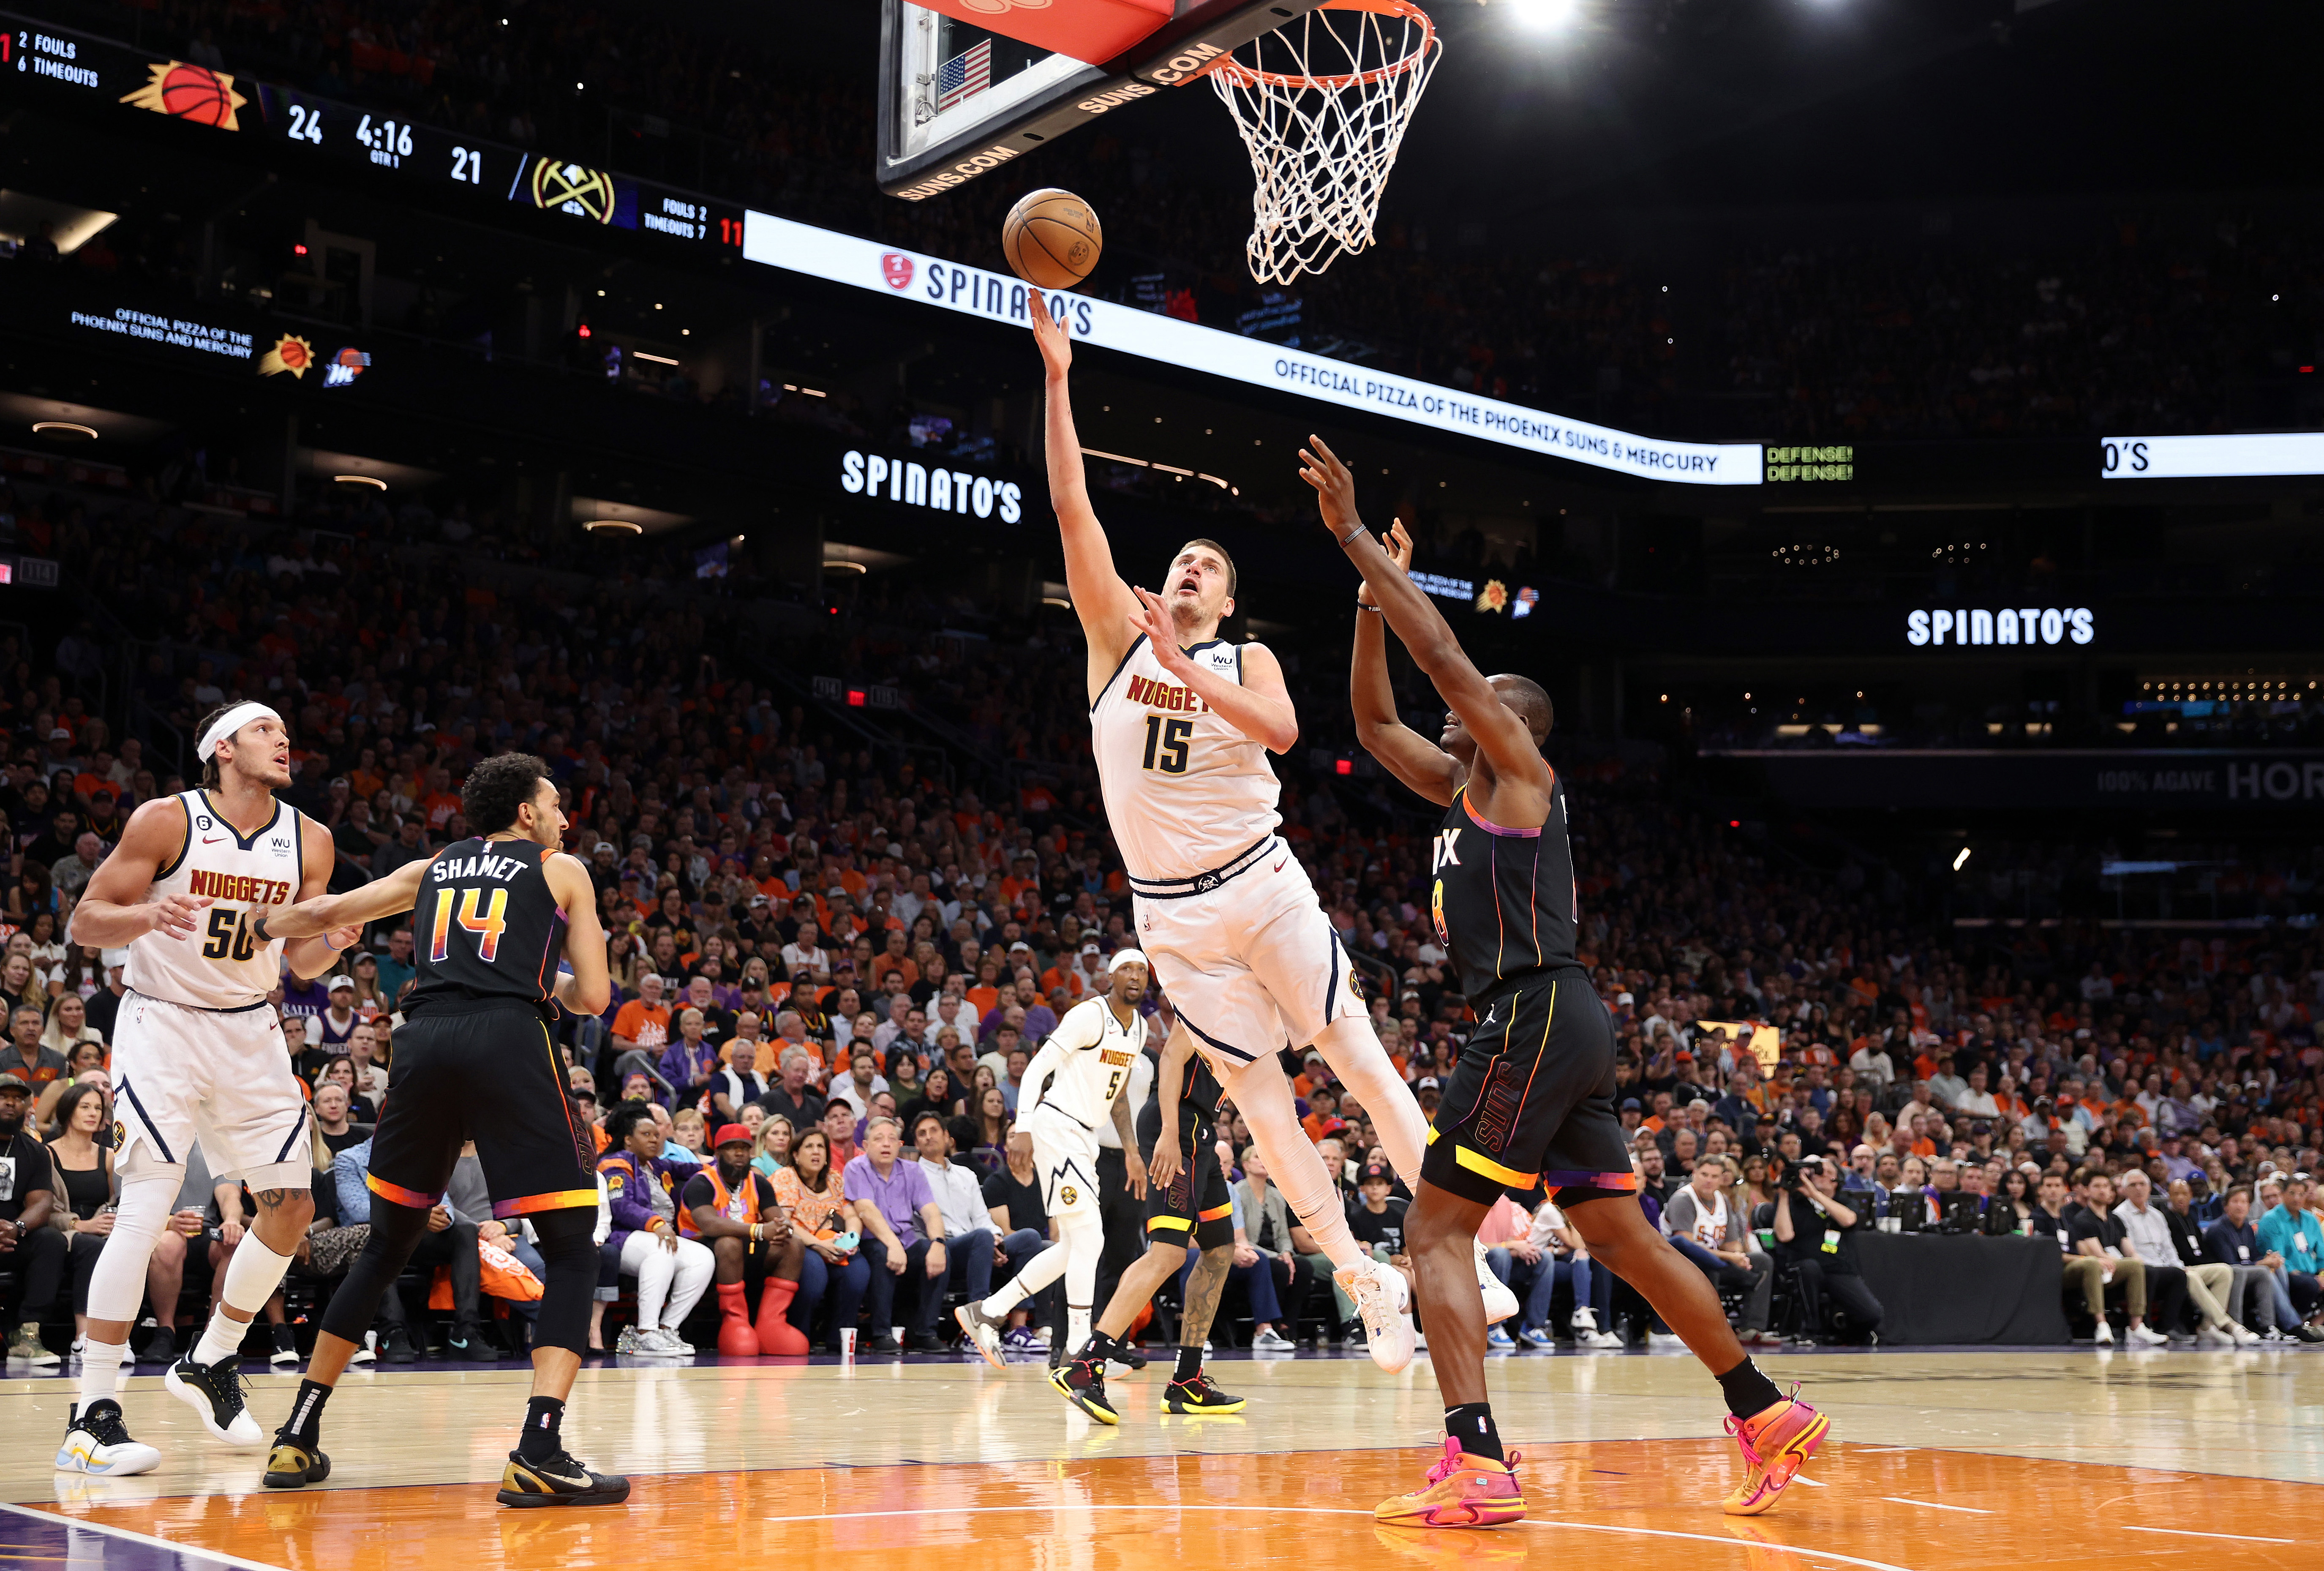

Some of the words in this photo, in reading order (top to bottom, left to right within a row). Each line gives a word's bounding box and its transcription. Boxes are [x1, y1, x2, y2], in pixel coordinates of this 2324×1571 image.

[19, 31, 27, 48] 2
[35, 33, 76, 59] FOULS
[18, 56, 26, 71] 6
[33, 56, 98, 87] TIMEOUTS
[1078, 43, 1225, 113] SUNS.COM
[288, 104, 322, 145] 24
[356, 115, 413, 156] 4:16
[370, 150, 391, 167] QTR
[393, 155, 399, 169] 1
[451, 146, 481, 184] 21
[897, 146, 1019, 201] SUNS.COM
[643, 213, 694, 239] TIMEOUTS
[698, 224, 706, 240] 7
[663, 198, 695, 219] FOULS
[699, 206, 707, 221] 2
[720, 218, 742, 247] 11
[927, 264, 1091, 335] SPINAO'S
[71, 311, 128, 334] PHOENIX
[129, 323, 164, 342] SUNS
[165, 332, 193, 347] AND
[194, 337, 253, 359] MERCURY
[115, 308, 171, 330] OFFICIAL
[173, 319, 209, 338] PIZZA
[210, 327, 227, 341] OF
[229, 330, 253, 347] THE
[1275, 359, 1361, 396] OFFICIAL
[1367, 382, 1418, 409] PIZZA
[1423, 396, 1444, 414] OF
[1449, 402, 1478, 424] THE
[1485, 411, 1560, 445] PHOENIX
[1565, 431, 1608, 455] SUNS
[1613, 443, 1622, 458] &
[1627, 446, 1719, 472] MERCURY
[1767, 446, 1853, 463] DEFENSE!
[1767, 464, 1853, 481] DEFENSE!
[841, 450, 1021, 524] SPINATO'S
[1907, 608, 2094, 646] SPINATO'S
[1213, 653, 1232, 664] WU
[1142, 714, 1194, 775] 15
[2097, 770, 2148, 792] 100%
[2153, 770, 2215, 792] AGAVE
[200, 817, 210, 830] 6
[271, 837, 290, 848] WU
[433, 854, 529, 883] SHAMET
[190, 869, 291, 905] NUGGETS
[430, 887, 508, 963] 14
[1106, 1071, 1121, 1100] 5
[1474, 1061, 1526, 1152] SUNS
